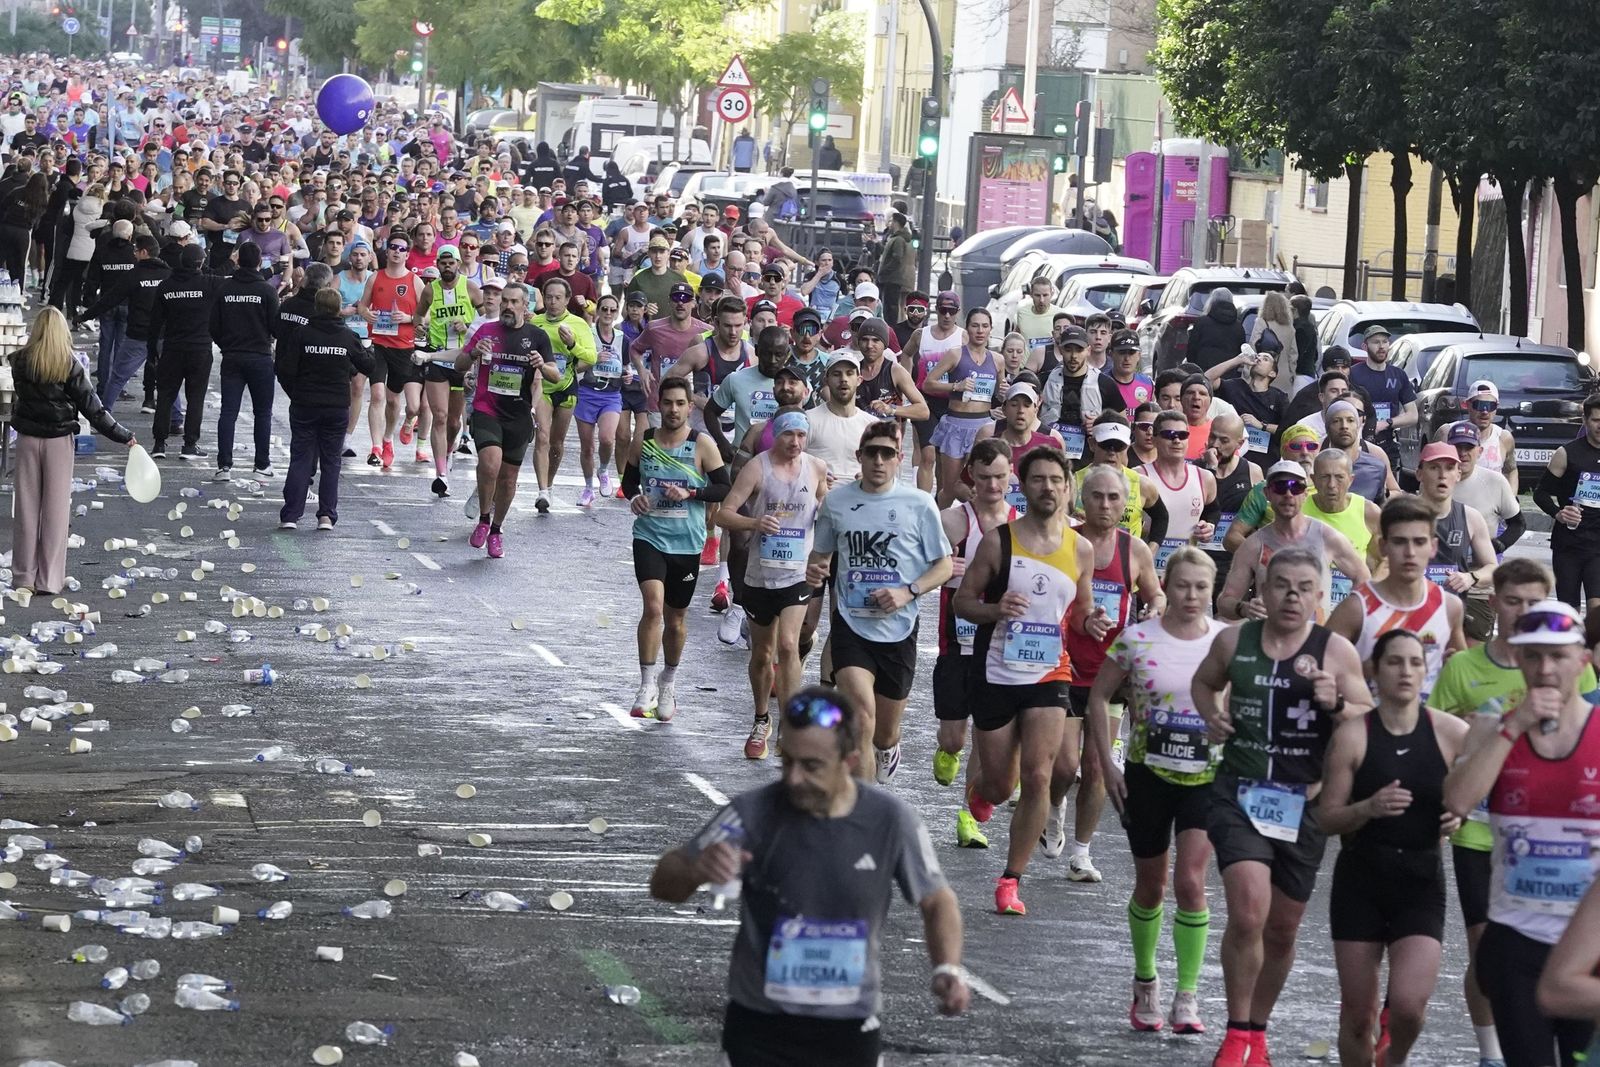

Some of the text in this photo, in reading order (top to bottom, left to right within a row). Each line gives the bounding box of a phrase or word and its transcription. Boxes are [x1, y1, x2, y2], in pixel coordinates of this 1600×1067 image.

[724, 99, 744, 111] 30
[164, 291, 203, 300] VOLUNTEER
[224, 295, 262, 303] VOLUNTEER
[436, 306, 466, 318] IRWL
[304, 346, 347, 356] VOLUNTEER
[495, 380, 513, 389] JORGE
[844, 530, 884, 558] 10K
[772, 549, 793, 559] PATO
[864, 573, 894, 581] ZURICH
[1091, 582, 1118, 591] ZURICH
[1025, 626, 1056, 634] ZURICH
[1018, 649, 1045, 661] FELIX
[1172, 716, 1206, 727] ZURICH
[1161, 742, 1196, 759] LUCIE
[1534, 843, 1583, 856] ZURICH
[1515, 878, 1581, 897] ANTOINE
[781, 965, 848, 985] LUISMA
